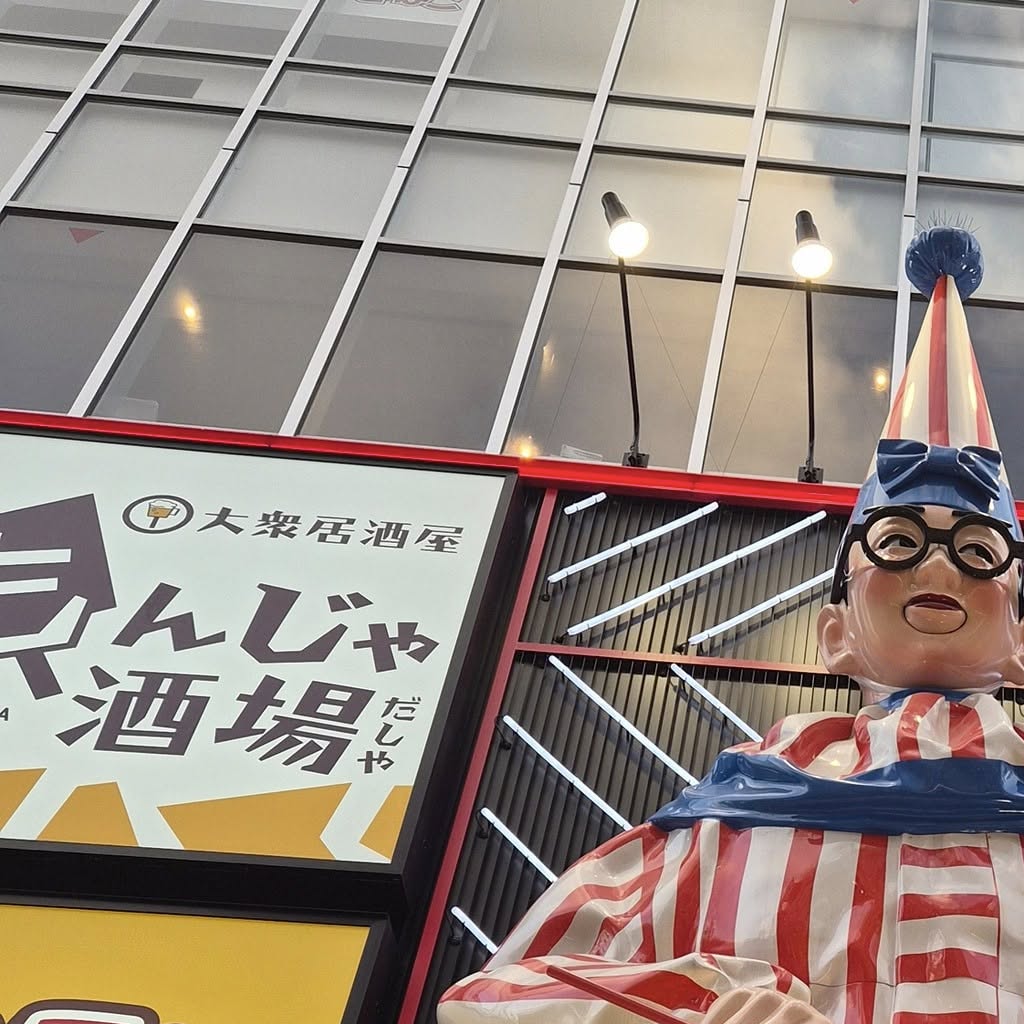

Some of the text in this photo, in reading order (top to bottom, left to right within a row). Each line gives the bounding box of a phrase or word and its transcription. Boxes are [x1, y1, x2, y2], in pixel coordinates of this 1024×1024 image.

[197, 506, 464, 554] 大衆居酒屋
[55, 664, 376, 776] 酒場
[357, 694, 423, 775] だしや
